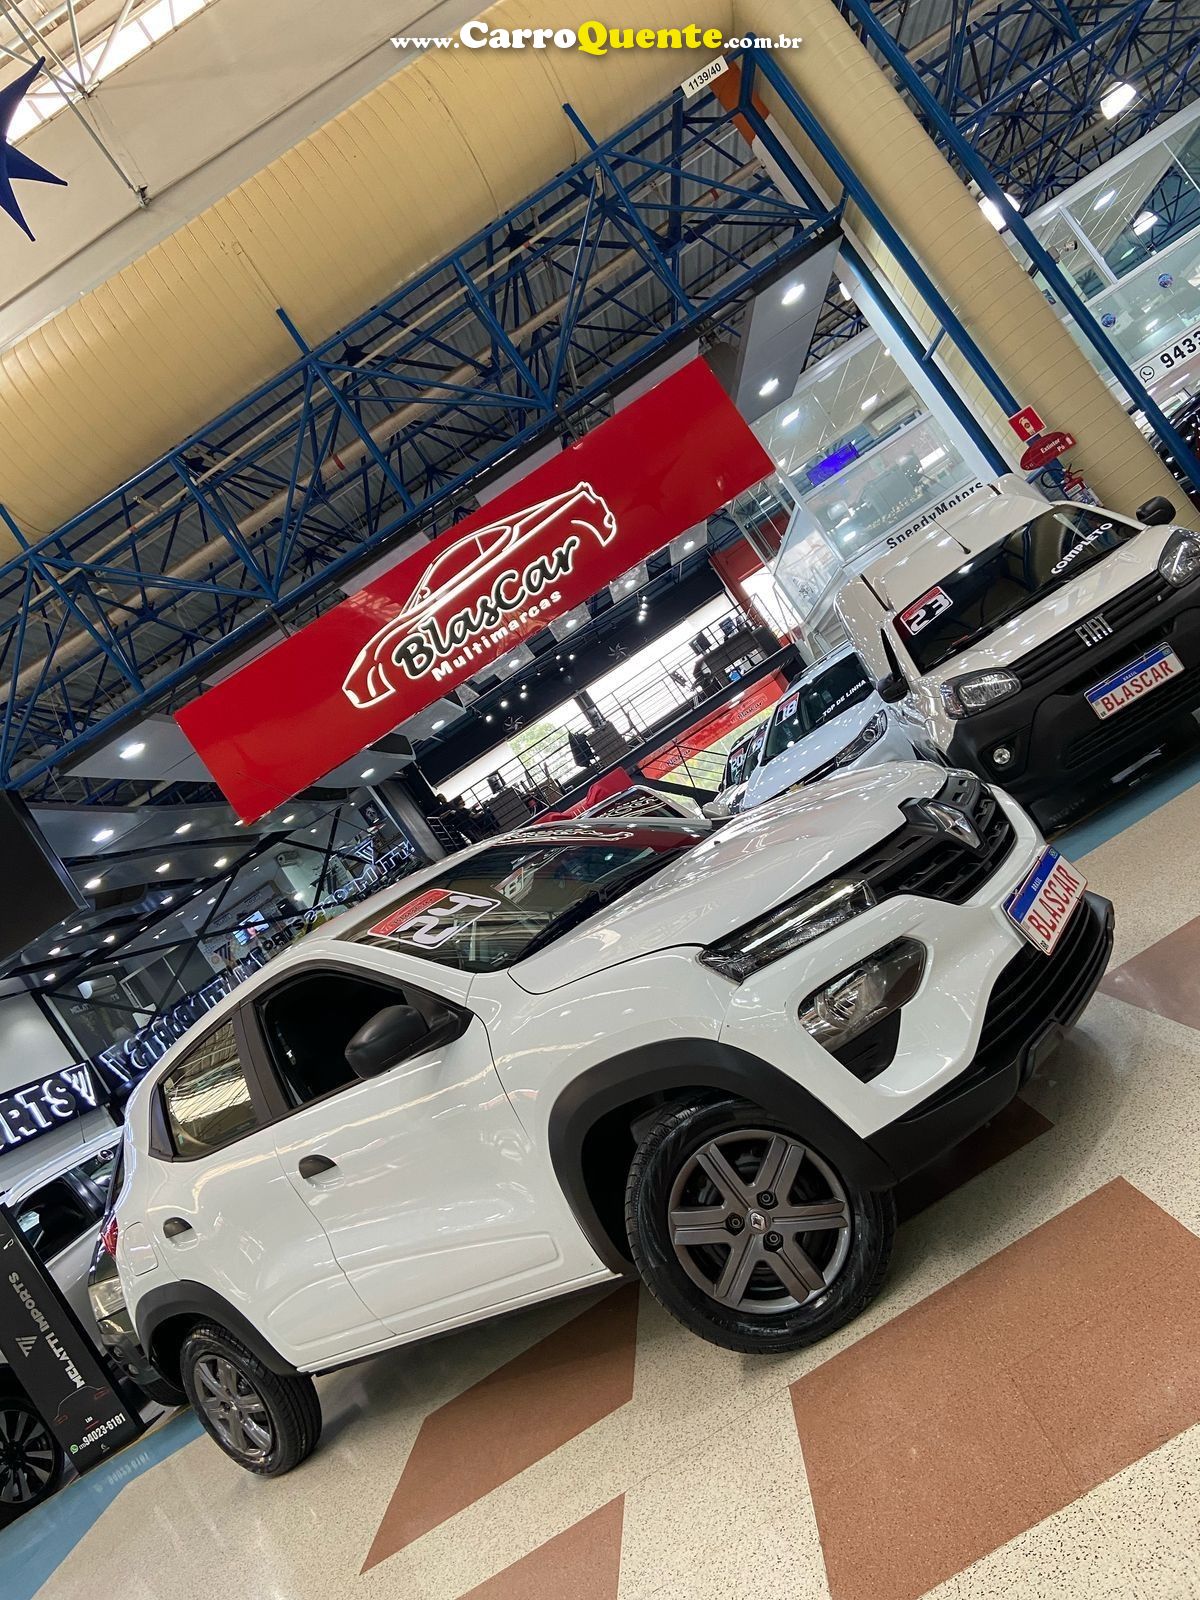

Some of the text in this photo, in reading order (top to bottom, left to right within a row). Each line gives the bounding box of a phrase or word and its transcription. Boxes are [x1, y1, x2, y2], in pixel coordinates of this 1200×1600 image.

[688, 62, 722, 91] 1139/40
[1050, 521, 1114, 575] COMPLETO
[430, 590, 562, 682] Multimarcas
[909, 594, 952, 632] 23
[1074, 612, 1114, 648] FIAT
[822, 679, 867, 717] TOP DE LINHA
[1101, 659, 1174, 713] BLASCAR
[395, 895, 493, 945] 24
[1027, 864, 1080, 942] BLASCAR
[8, 1271, 86, 1389] MELATTI IMPORTS
